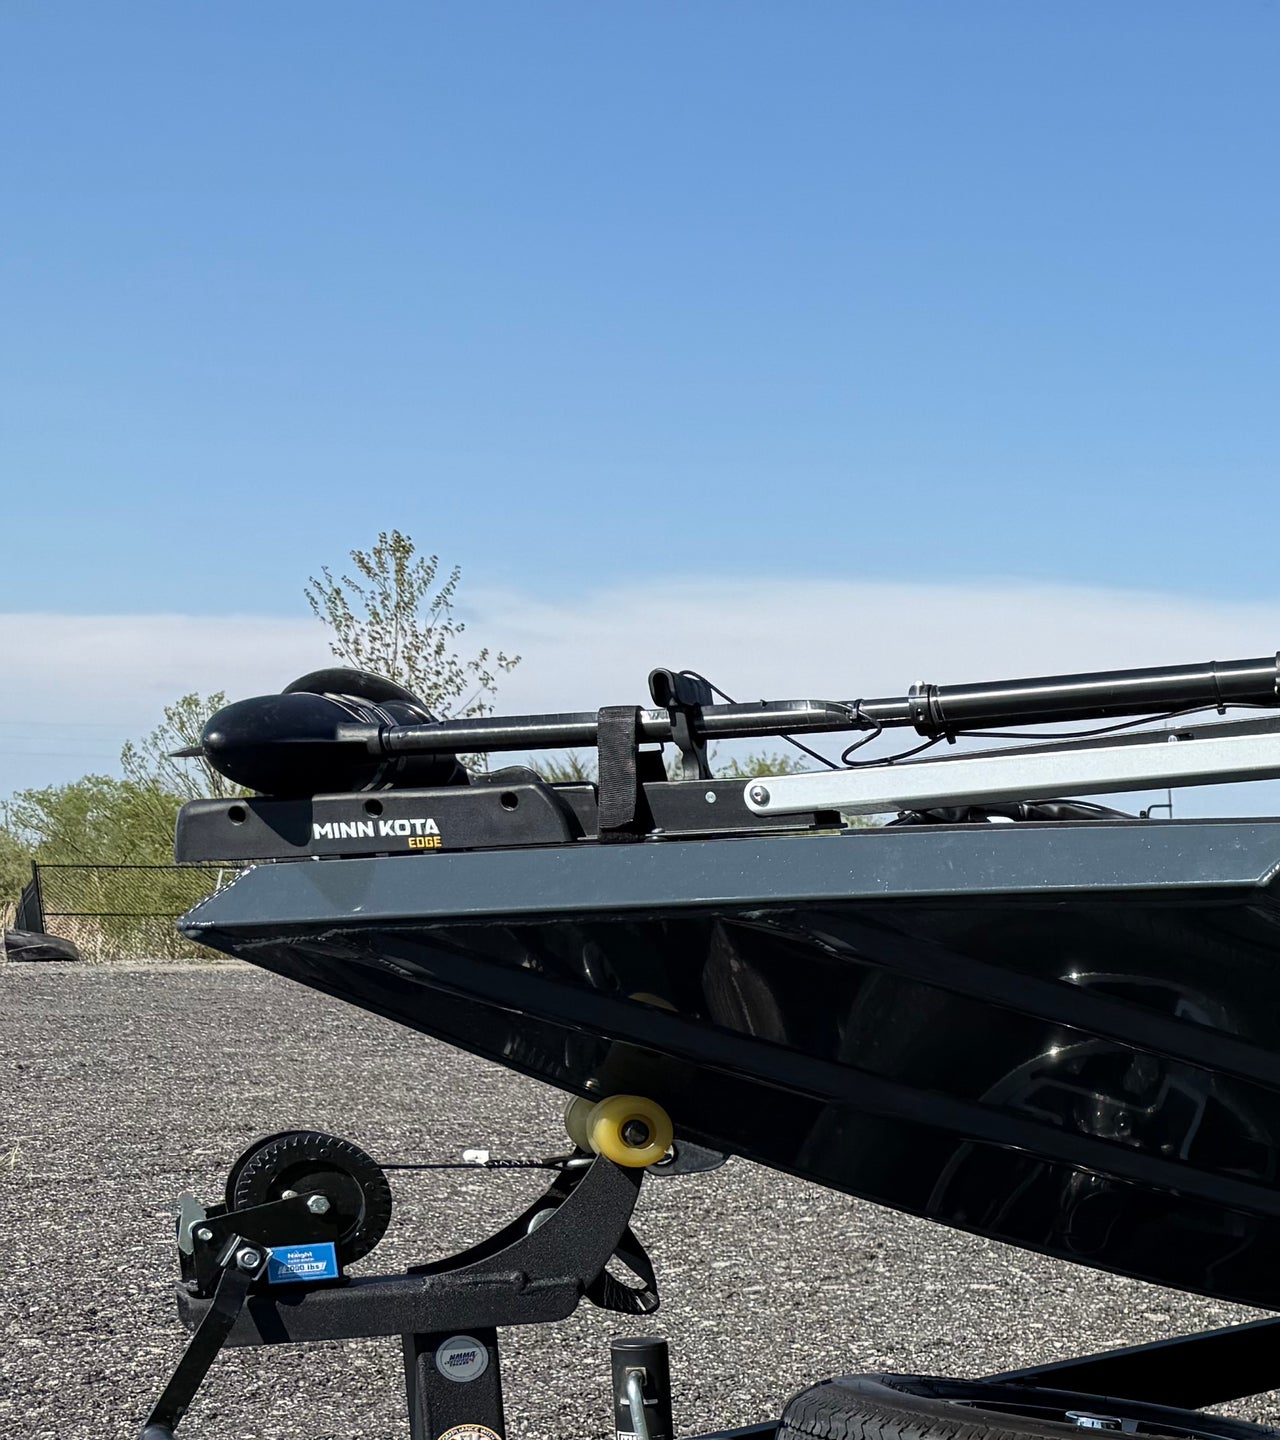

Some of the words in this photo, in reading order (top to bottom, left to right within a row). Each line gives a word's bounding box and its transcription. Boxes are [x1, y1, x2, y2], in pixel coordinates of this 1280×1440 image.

[313, 820, 375, 840] MINN
[379, 818, 440, 837] KOTA
[408, 836, 442, 848] EDGE
